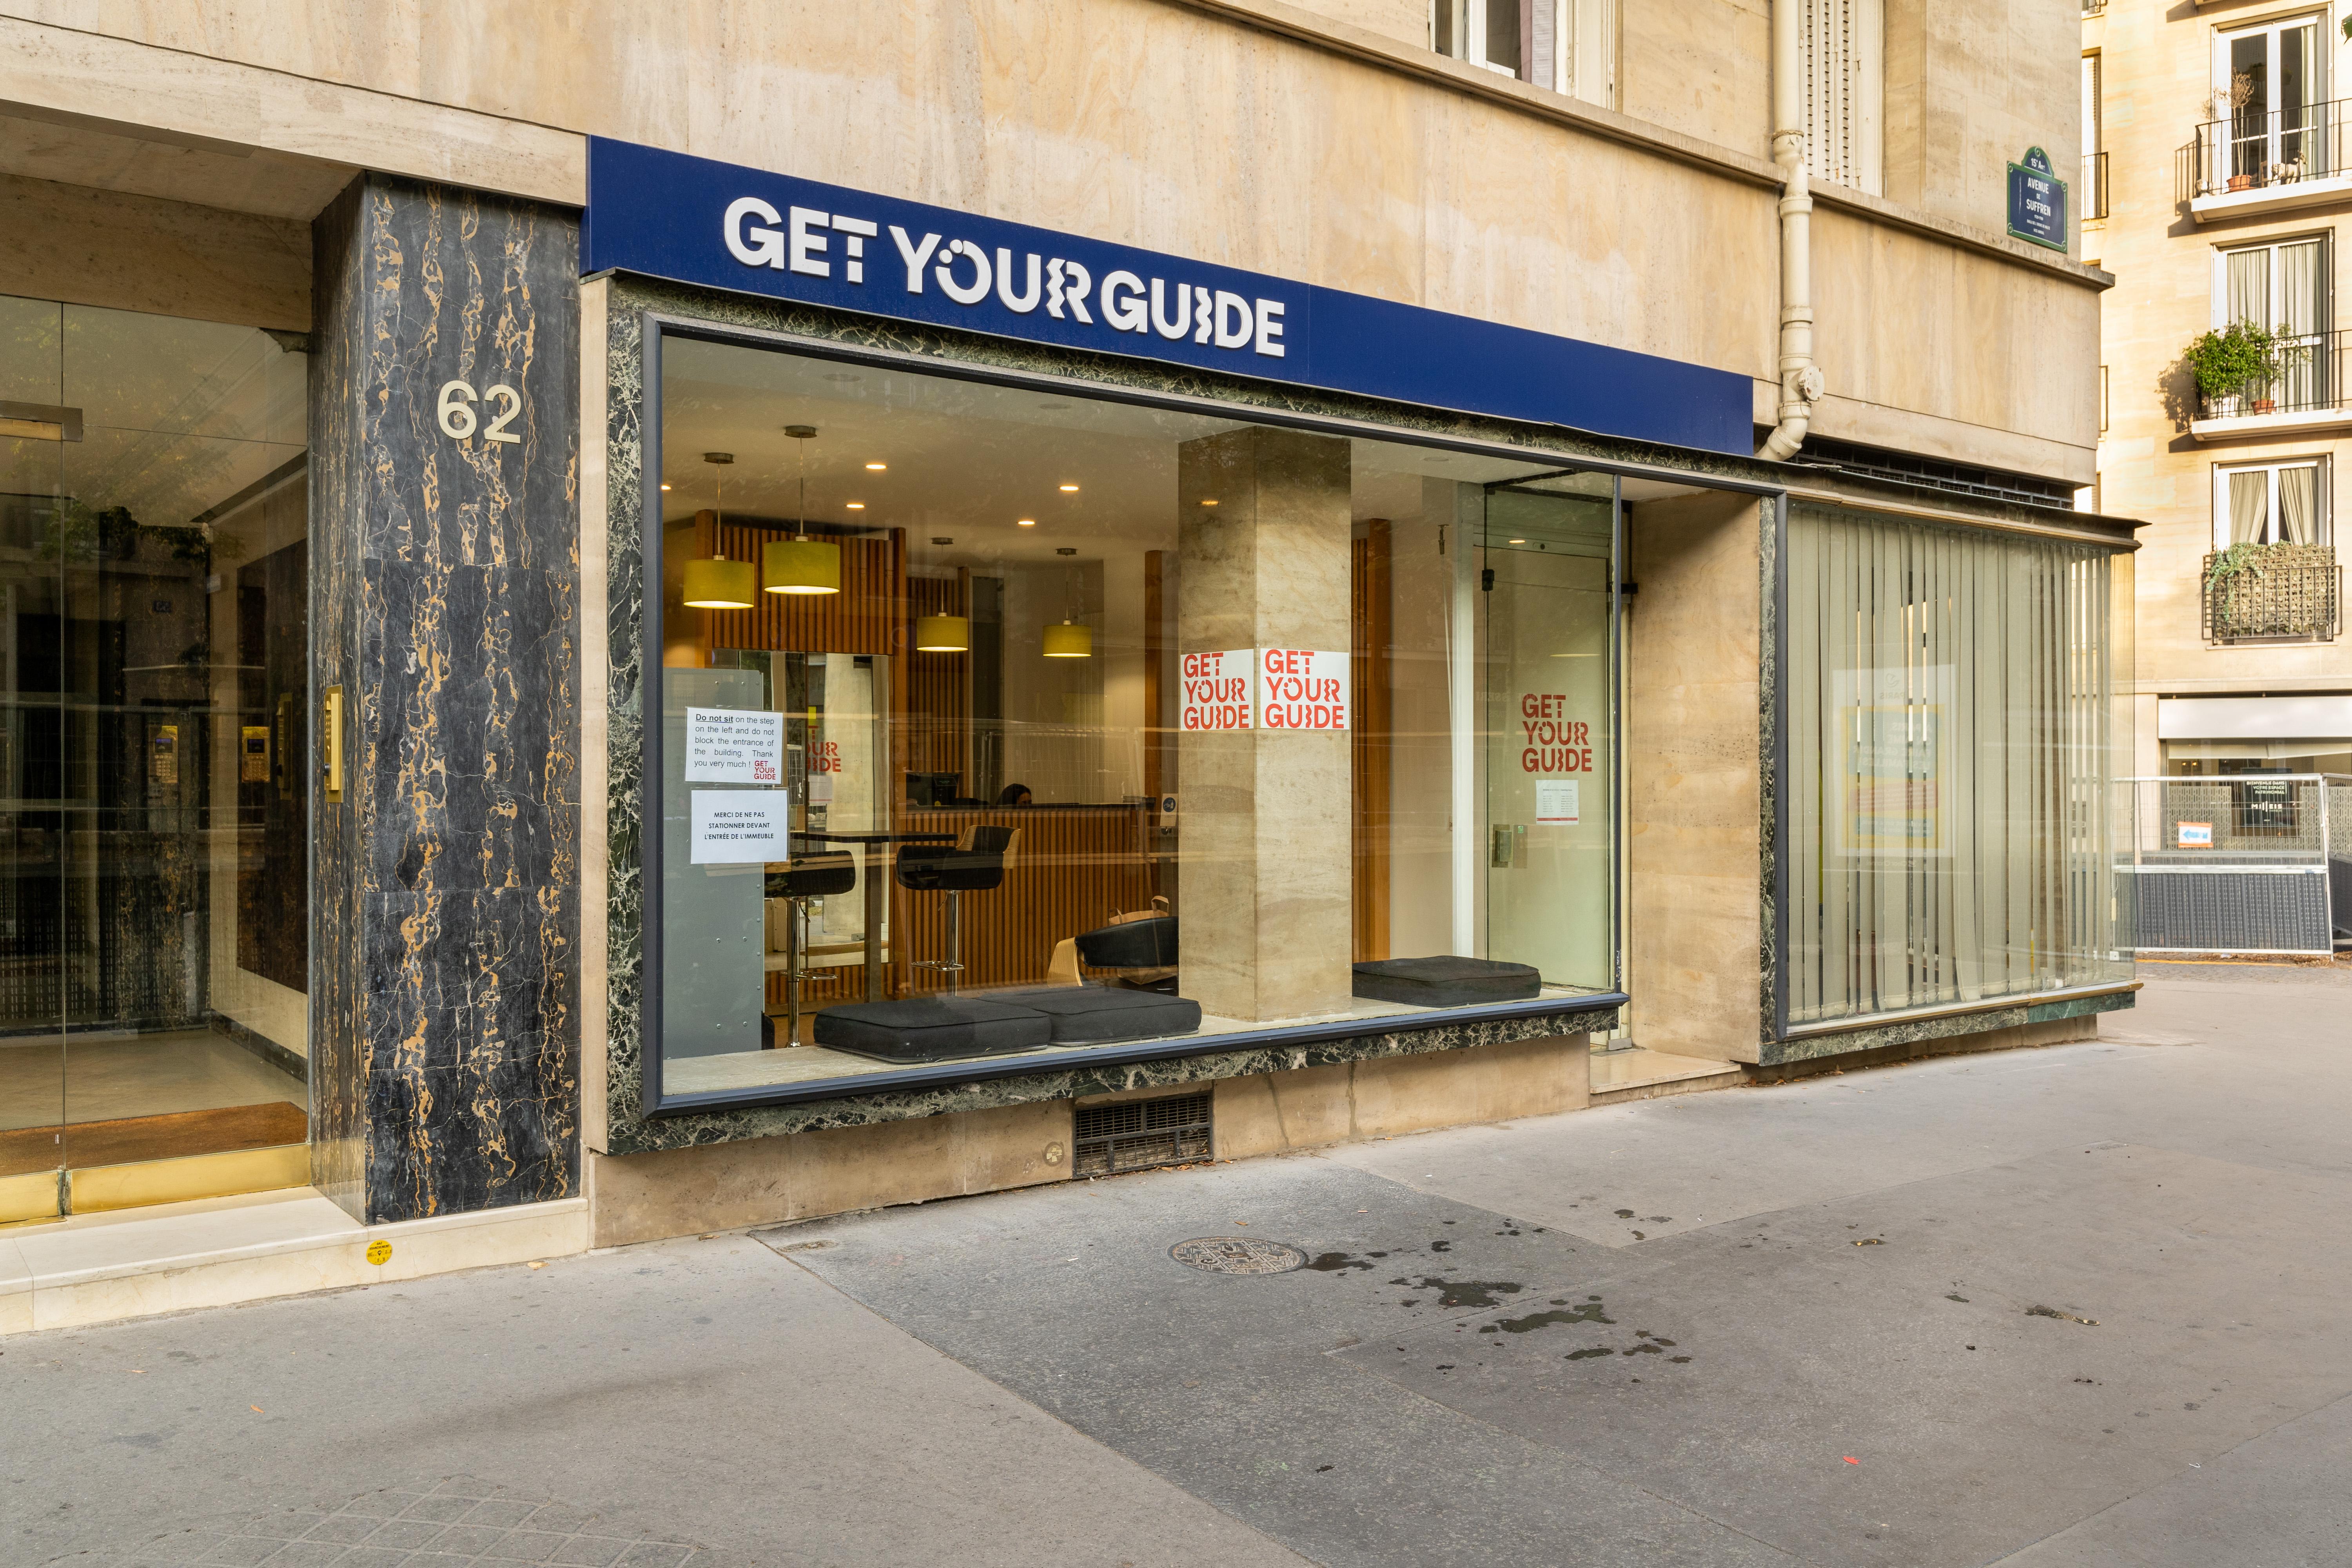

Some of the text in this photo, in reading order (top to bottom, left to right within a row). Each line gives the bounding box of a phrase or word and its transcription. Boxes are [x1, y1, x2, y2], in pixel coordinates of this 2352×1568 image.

[2027, 177, 2049, 194] AVENUE
[2026, 199, 2051, 216] SUFFREN
[724, 197, 1285, 358] GET YOUR GUIDE
[437, 380, 521, 444] 62
[1184, 652, 1224, 678] GET
[1265, 649, 1314, 675] GET
[1184, 678, 1246, 704] YOUR
[1265, 676, 1340, 702] YOUR
[1184, 704, 1249, 730] GUIDE
[1265, 704, 1344, 729] GUIDE
[1522, 694, 1566, 718] GET
[1522, 721, 1589, 746] YOUR
[714, 749, 744, 758] building.
[1522, 748, 1592, 772] GUIDE
